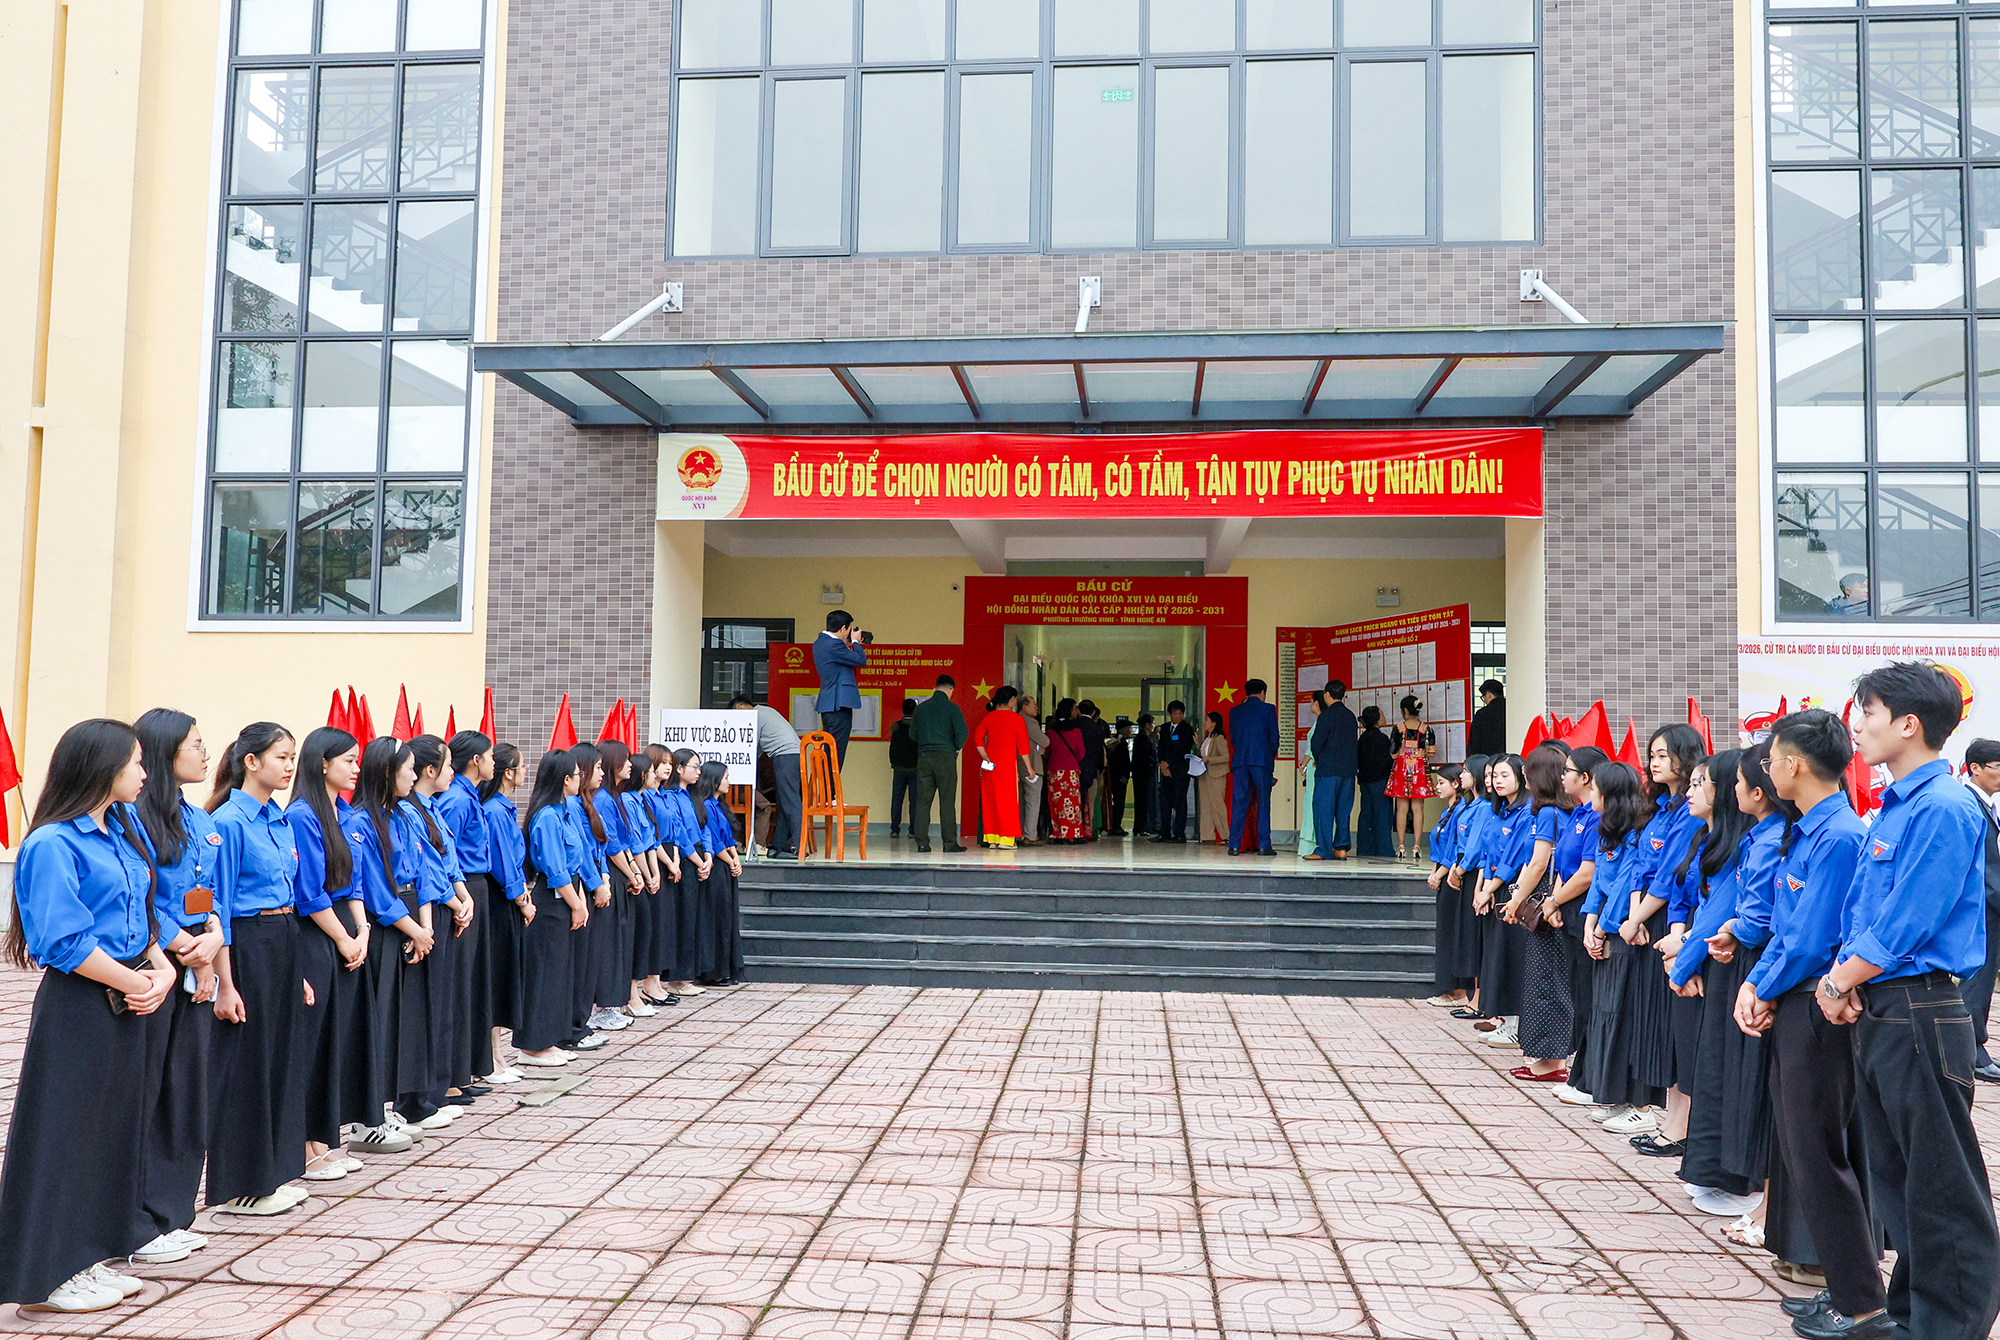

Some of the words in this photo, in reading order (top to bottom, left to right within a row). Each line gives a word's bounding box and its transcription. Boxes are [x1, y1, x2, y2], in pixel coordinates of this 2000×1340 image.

[773, 451, 813, 497] BẦU
[819, 452, 849, 497] CỬ
[852, 449, 879, 497] ĐỂ
[884, 463, 939, 505] CHỌN
[946, 454, 1008, 497] NGƯỜI
[1015, 455, 1041, 497] CÓ
[1048, 455, 1098, 501] TÂM,
[1105, 455, 1132, 497] CÓ
[1138, 449, 1189, 501] TẦM,
[1196, 454, 1237, 504] TẬN
[1243, 461, 1282, 503] TỤY
[1288, 460, 1344, 503] PHỤC
[1350, 460, 1378, 503] VỤ
[1385, 452, 1444, 494] NHÂN
[1451, 451, 1503, 494] DÂN!
[1076, 578, 1107, 592] BẦU
[1111, 578, 1133, 592] CỬ
[1013, 595, 1029, 605] ĐẠI
[1031, 592, 1052, 603] BIỂU
[1054, 592, 1079, 604] QUỐC
[1081, 594, 1097, 605] HỘI
[1099, 594, 1124, 603] KHÓA
[1127, 595, 1142, 603] XVI
[1144, 594, 1156, 603] VÀ
[1158, 595, 1174, 605] ĐẠI
[1177, 592, 1198, 603] BIỂU
[986, 604, 1002, 615] HỘI
[1004, 603, 1029, 614] ĐỒNG
[1032, 604, 1058, 614] NHÂN
[1060, 604, 1079, 614] DÂN
[1082, 604, 1100, 614] CÁC
[1103, 604, 1121, 614] CẤP
[1124, 605, 1154, 616] NHIỆM
[1171, 606, 1194, 614] 2026
[1203, 606, 1224, 614] 2031
[1764, 641, 1774, 654] CỬ
[1775, 644, 1785, 654] TRI
[1787, 641, 1796, 654] CẢ
[1798, 642, 1816, 655] NƯỚC
[1818, 645, 1825, 655] ĐI
[1826, 642, 1840, 655] BẦU
[1841, 642, 1851, 655] CỬ
[1852, 645, 1863, 657] ĐẠI
[1865, 642, 1881, 655] BIỂU
[1882, 642, 1900, 657] QUỐC
[1902, 643, 1913, 658] HỘI
[1915, 644, 1933, 656] KHÓA
[1935, 646, 1946, 656] XVI
[1947, 644, 1956, 656] VÀ
[1958, 646, 1969, 659] ĐẠI
[1971, 643, 1987, 657] BIỂU
[1988, 644, 2000, 659] HỘI
[664, 727, 688, 742] KHU
[691, 725, 711, 747] VỰC
[714, 719, 736, 743] BẢO
[739, 723, 754, 747] VỆ
[724, 752, 751, 765] AREA
